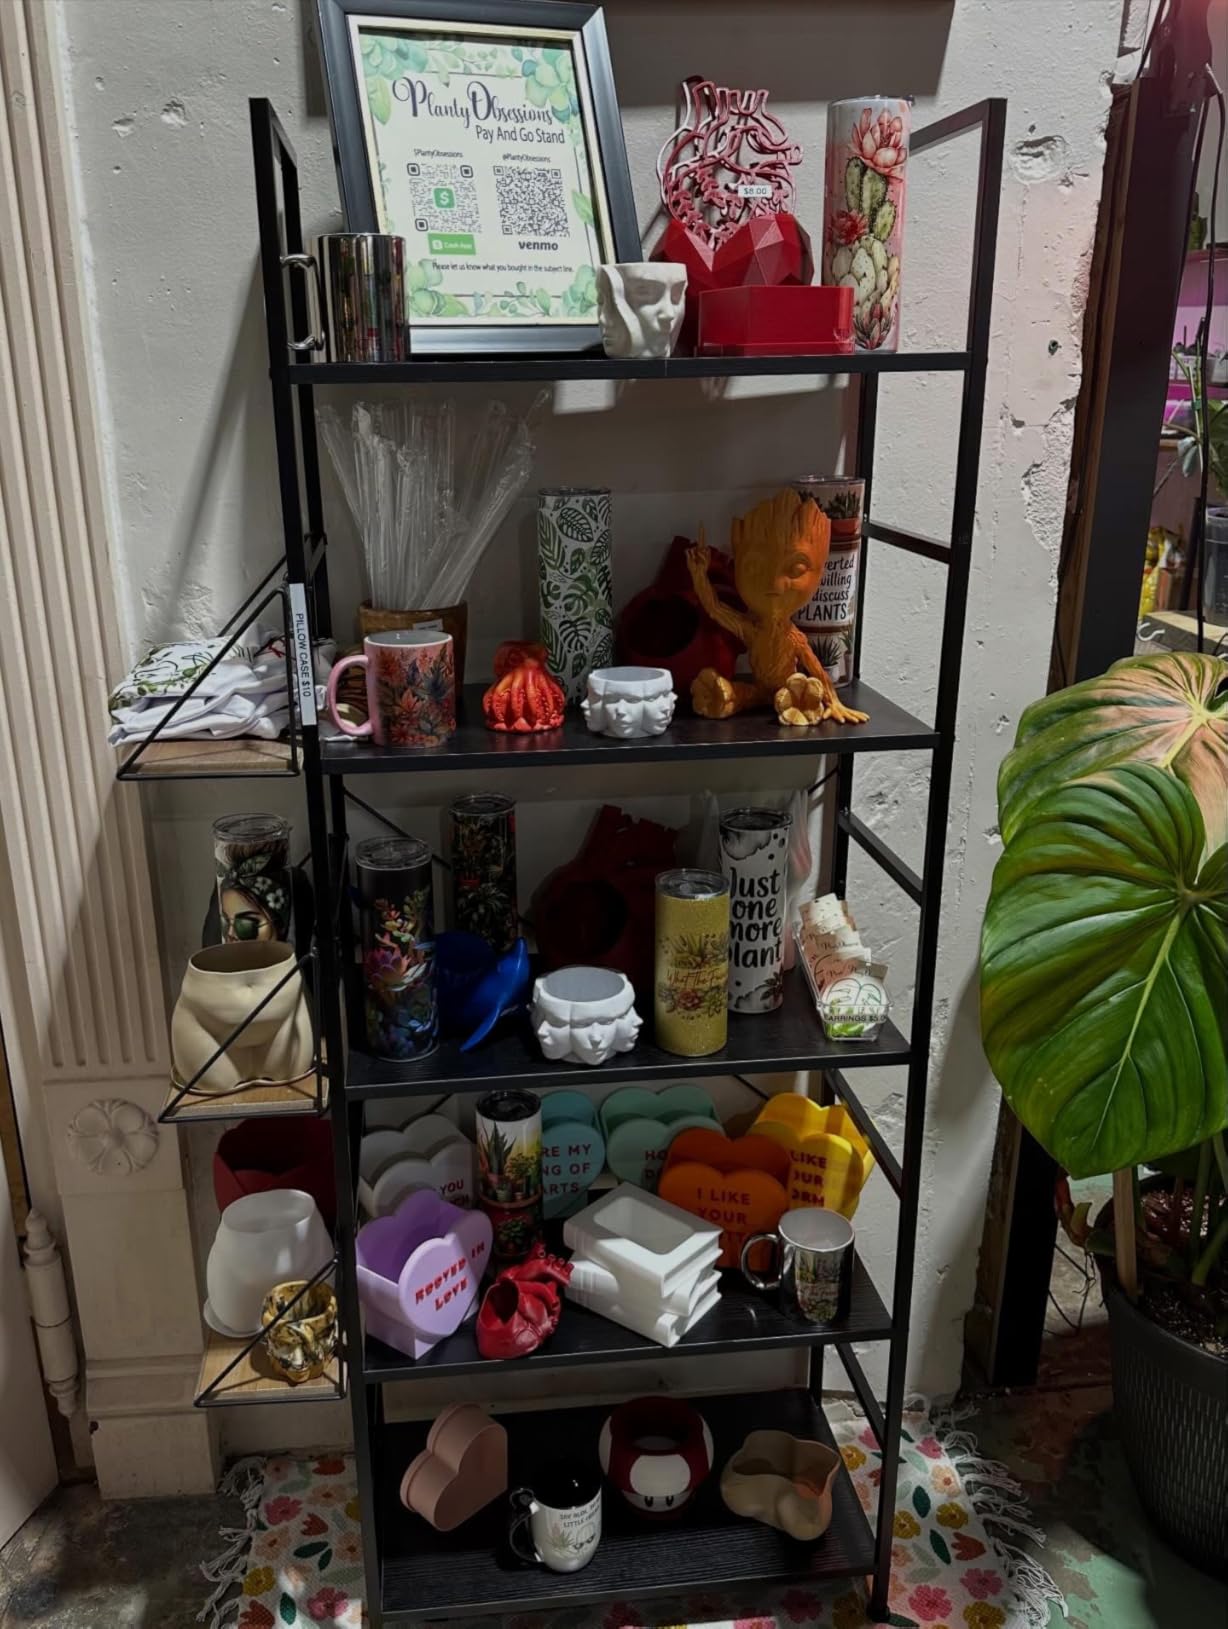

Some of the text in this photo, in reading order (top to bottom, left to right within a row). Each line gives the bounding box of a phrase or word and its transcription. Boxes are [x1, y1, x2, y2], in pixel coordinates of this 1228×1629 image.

[392, 76, 553, 128] Planty Obsessions
[475, 125, 566, 144] Pay And Go Stand
[743, 187, 767, 195] $8.00
[518, 241, 559, 251] venmo
[432, 262, 450, 271] Please
[466, 263, 481, 271] know
[482, 263, 496, 271] what
[496, 264, 507, 273] you
[507, 263, 527, 273] bought
[533, 264, 542, 272] the
[543, 264, 562, 274] subject
[563, 264, 574, 273] line.
[811, 588, 849, 602] discuss
[798, 603, 847, 620] PLANTS
[295, 613, 311, 698] PILLOW CASE $10
[732, 898, 778, 920] one
[729, 937, 782, 968] lant
[542, 1144, 591, 1157] RE MY
[790, 1150, 827, 1169] LIKE
[542, 1162, 591, 1176] NG OF
[440, 1179, 464, 1195] YOU
[795, 1170, 823, 1187] UR
[543, 1182, 579, 1195] RTS
[697, 1187, 751, 1206] I LIKE
[792, 1188, 825, 1207] ORM
[698, 1207, 746, 1225] YOUR
[471, 1241, 485, 1258] IN
[435, 1277, 468, 1311] LOVE
[563, 1517, 584, 1528] LITTLE
